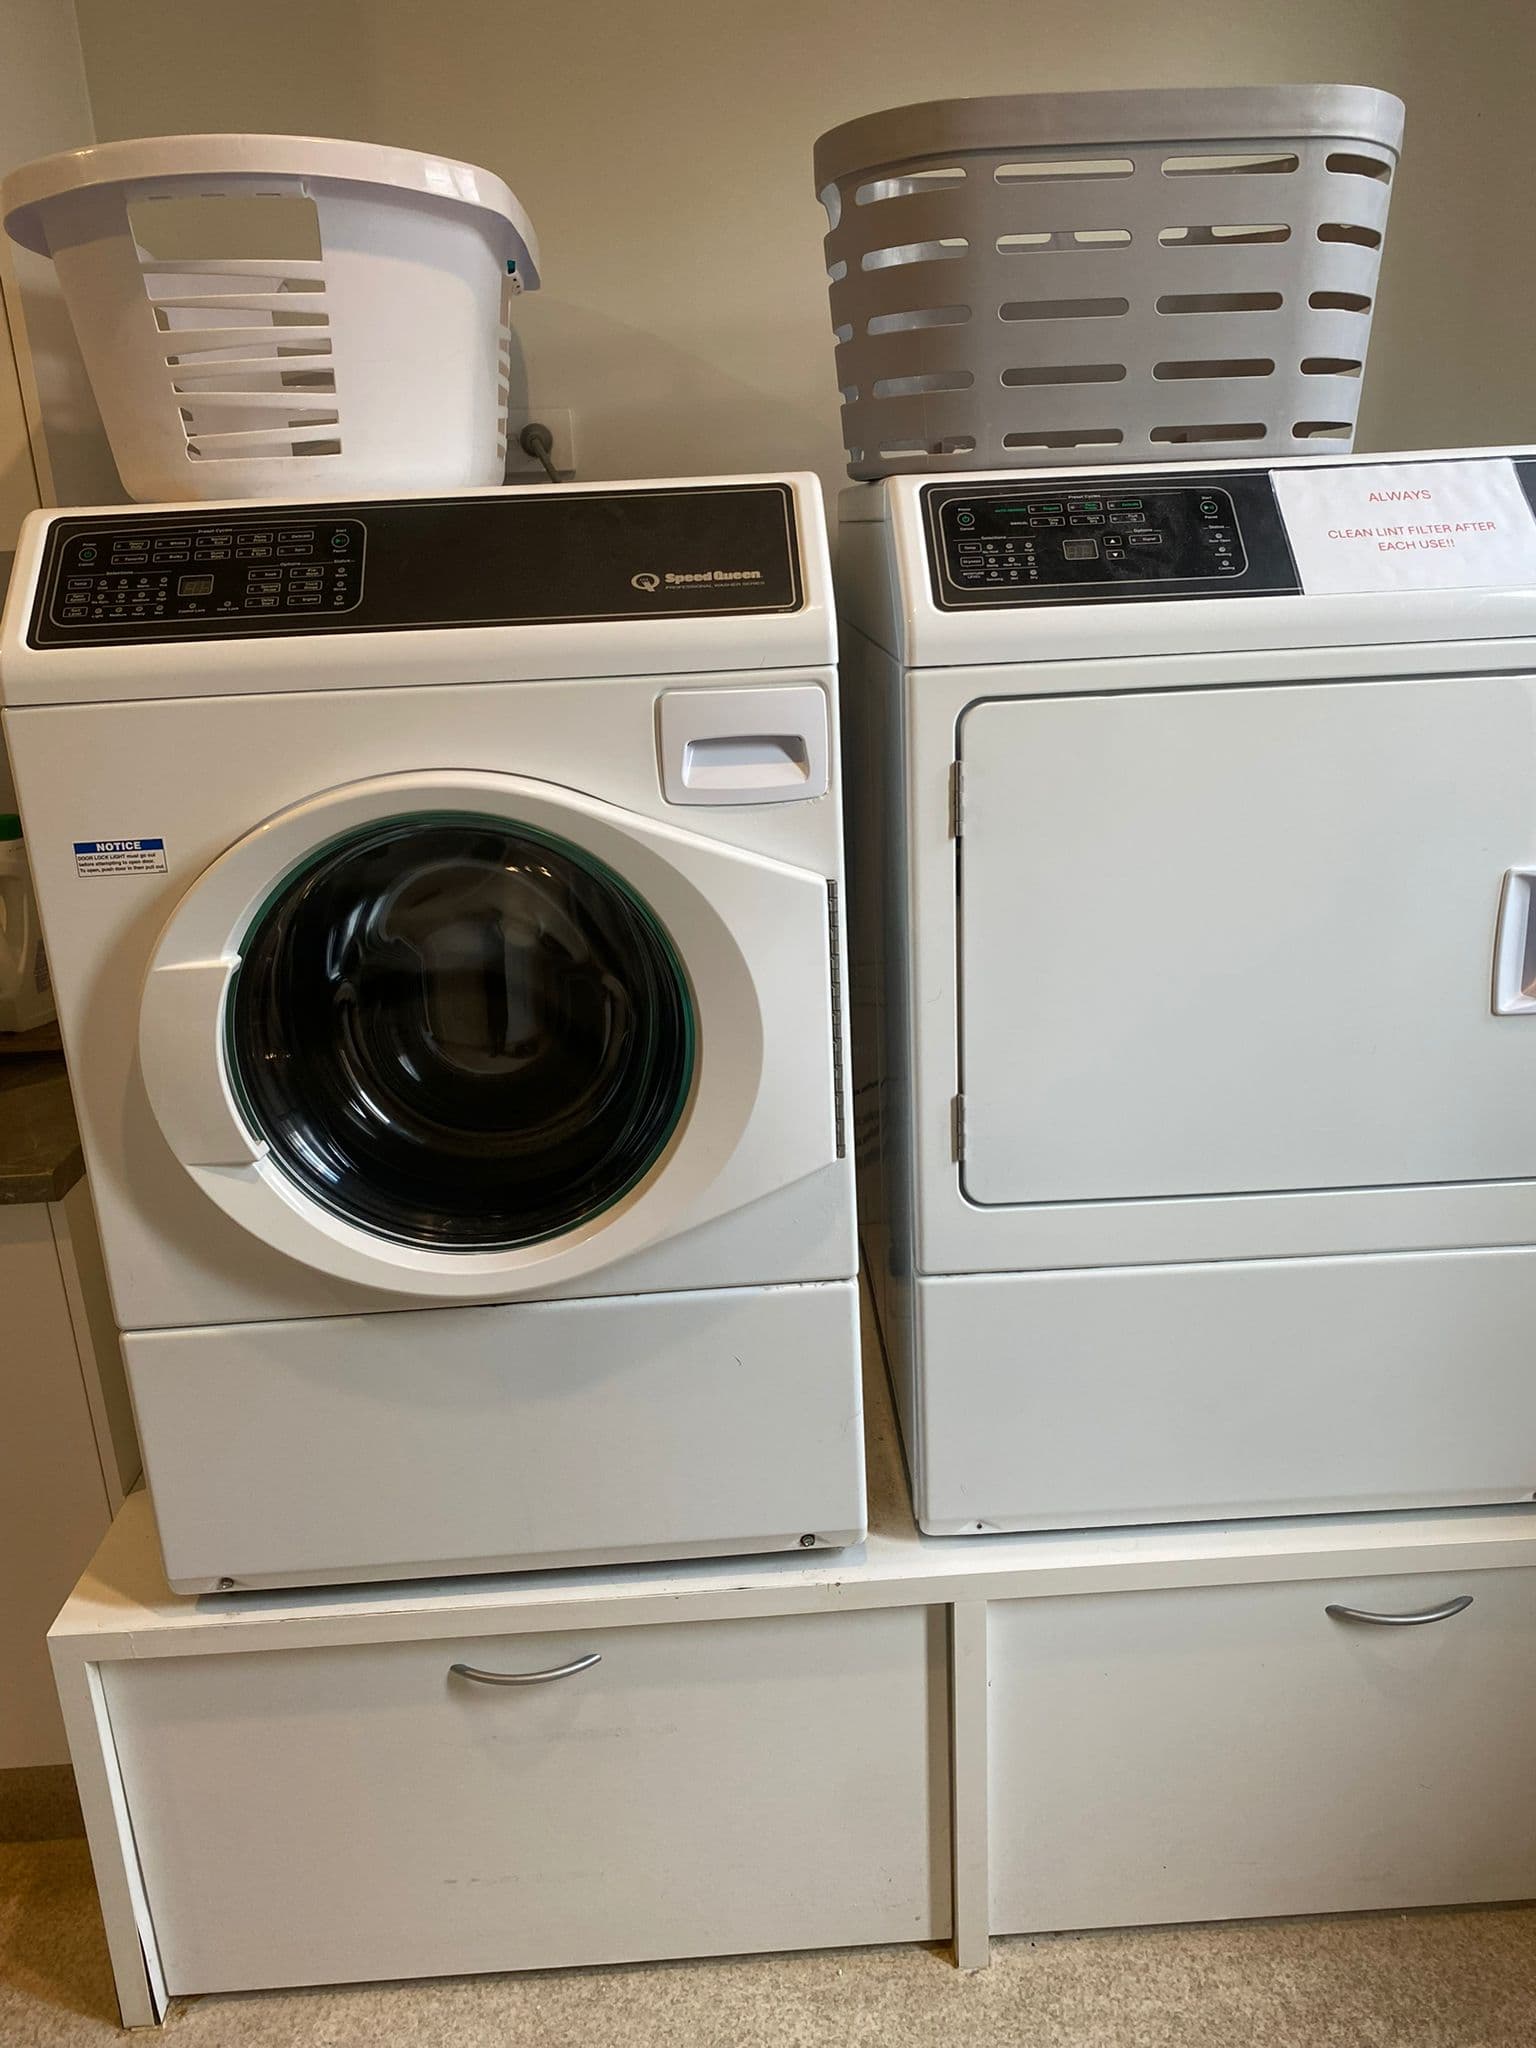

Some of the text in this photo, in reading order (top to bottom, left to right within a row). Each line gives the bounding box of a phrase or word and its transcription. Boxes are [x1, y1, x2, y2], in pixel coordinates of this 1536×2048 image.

[1368, 490, 1432, 502] ALWAYS
[1327, 521, 1497, 539] CLEAN LINT FILTER AFTER
[1378, 539, 1456, 552] EACH USE!!
[664, 571, 761, 585] Speed Queen
[95, 841, 142, 852] NOTICE
